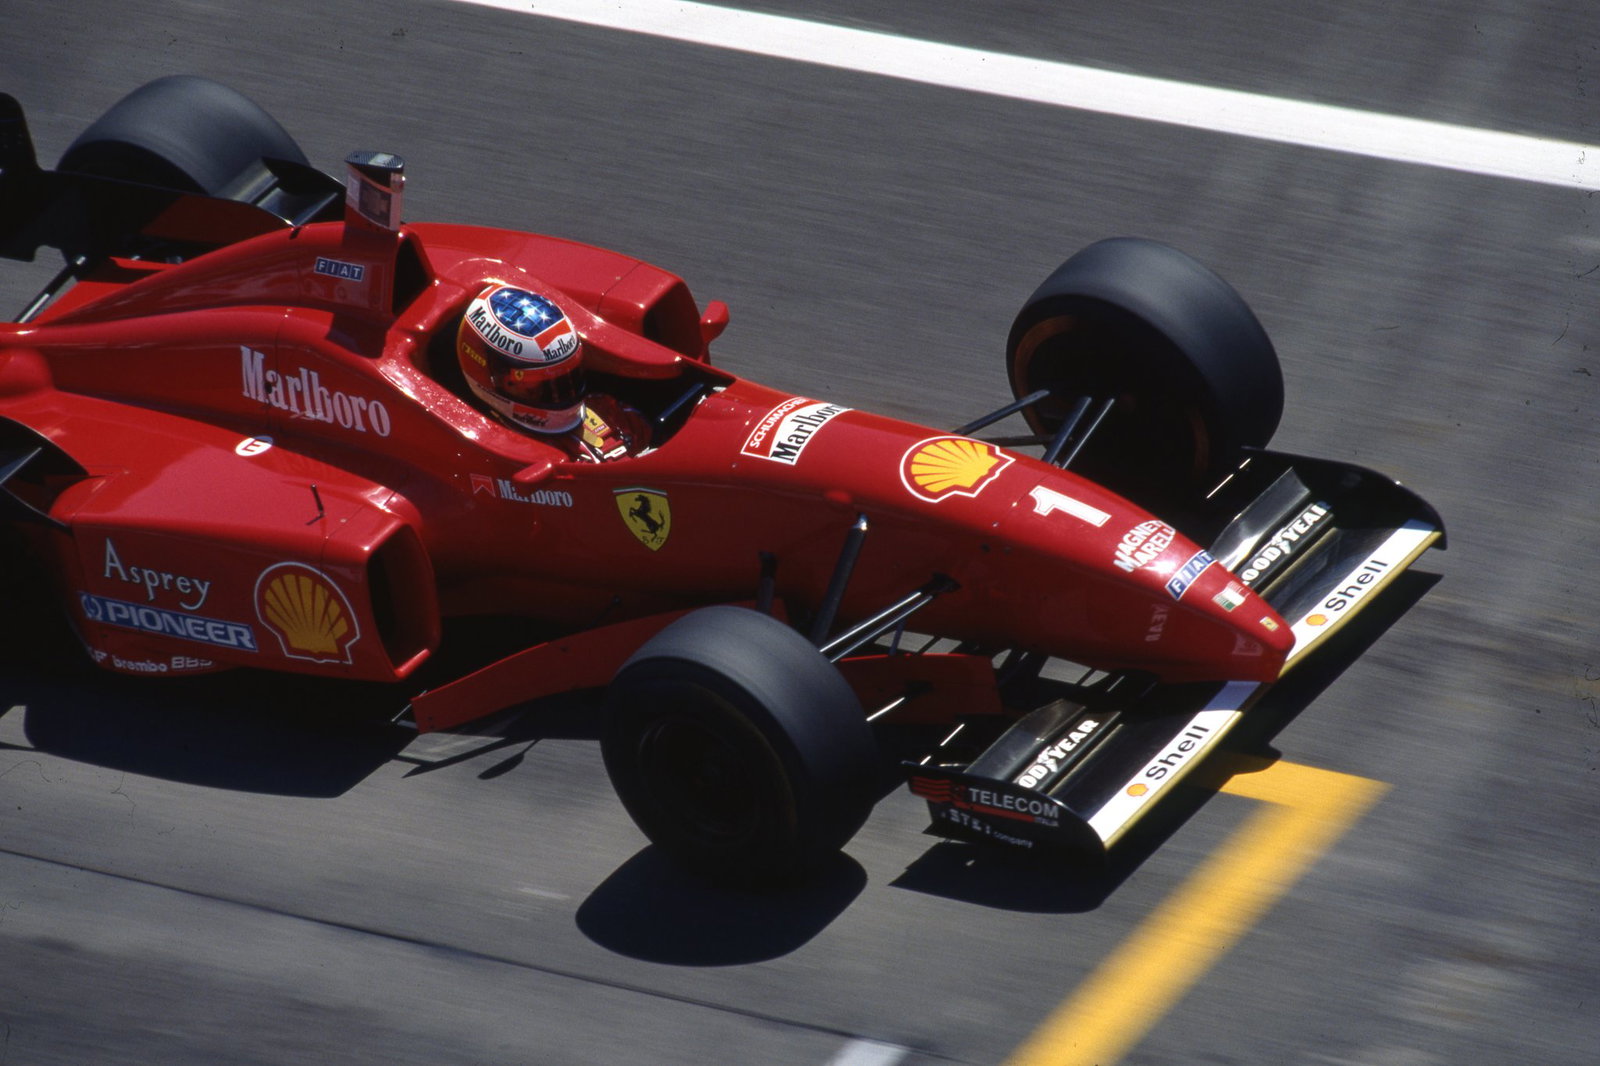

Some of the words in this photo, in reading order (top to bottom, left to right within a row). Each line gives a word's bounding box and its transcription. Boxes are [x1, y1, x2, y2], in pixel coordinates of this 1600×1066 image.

[317, 259, 363, 280] FIAT
[469, 307, 523, 354] Marlboro
[240, 345, 391, 437] Marlboro
[750, 398, 806, 448] SCHUMACHE
[770, 404, 841, 462] Marlbor
[497, 478, 573, 508] Mboro
[1028, 485, 1112, 527] 1
[1241, 501, 1331, 586] OODYEAR
[104, 538, 211, 610] Asprey
[1169, 551, 1216, 595] FIAT
[1325, 560, 1388, 612] Shell
[106, 601, 255, 649] PIONEER
[111, 654, 168, 673] brembo
[1018, 719, 1100, 789] ODYEAR
[1145, 725, 1210, 780] Shell
[968, 788, 1060, 819] TELECOM
